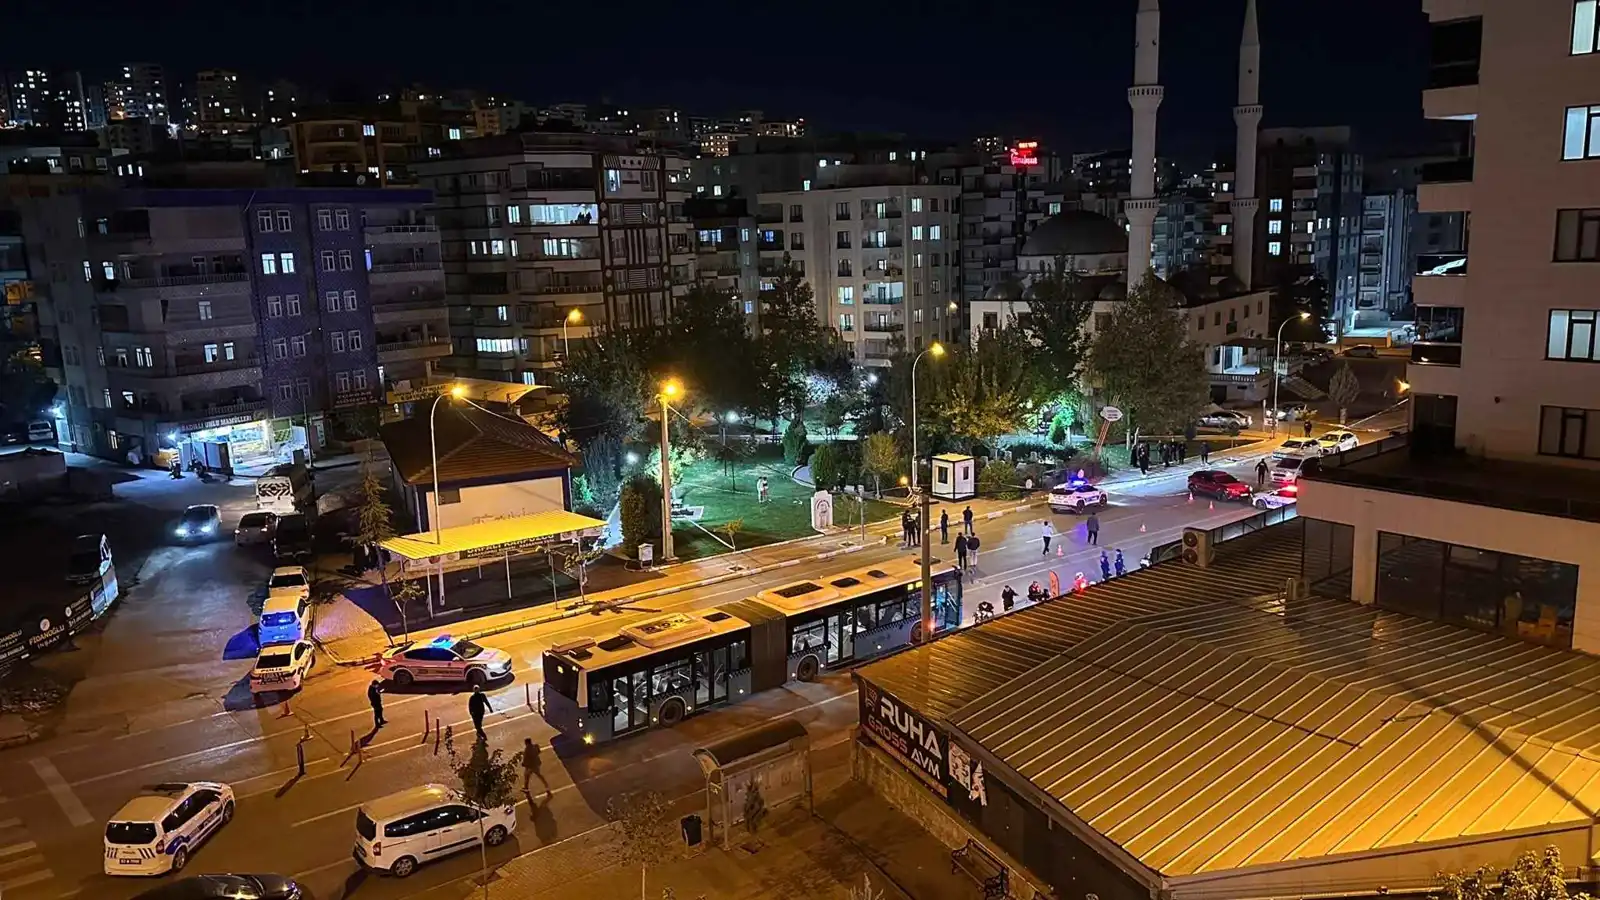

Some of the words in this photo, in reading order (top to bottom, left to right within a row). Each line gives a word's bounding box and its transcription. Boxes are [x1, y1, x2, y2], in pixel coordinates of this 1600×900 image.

[867, 713, 908, 754] GROSS
[880, 696, 943, 761] RUHA
[911, 747, 941, 780] AVM
